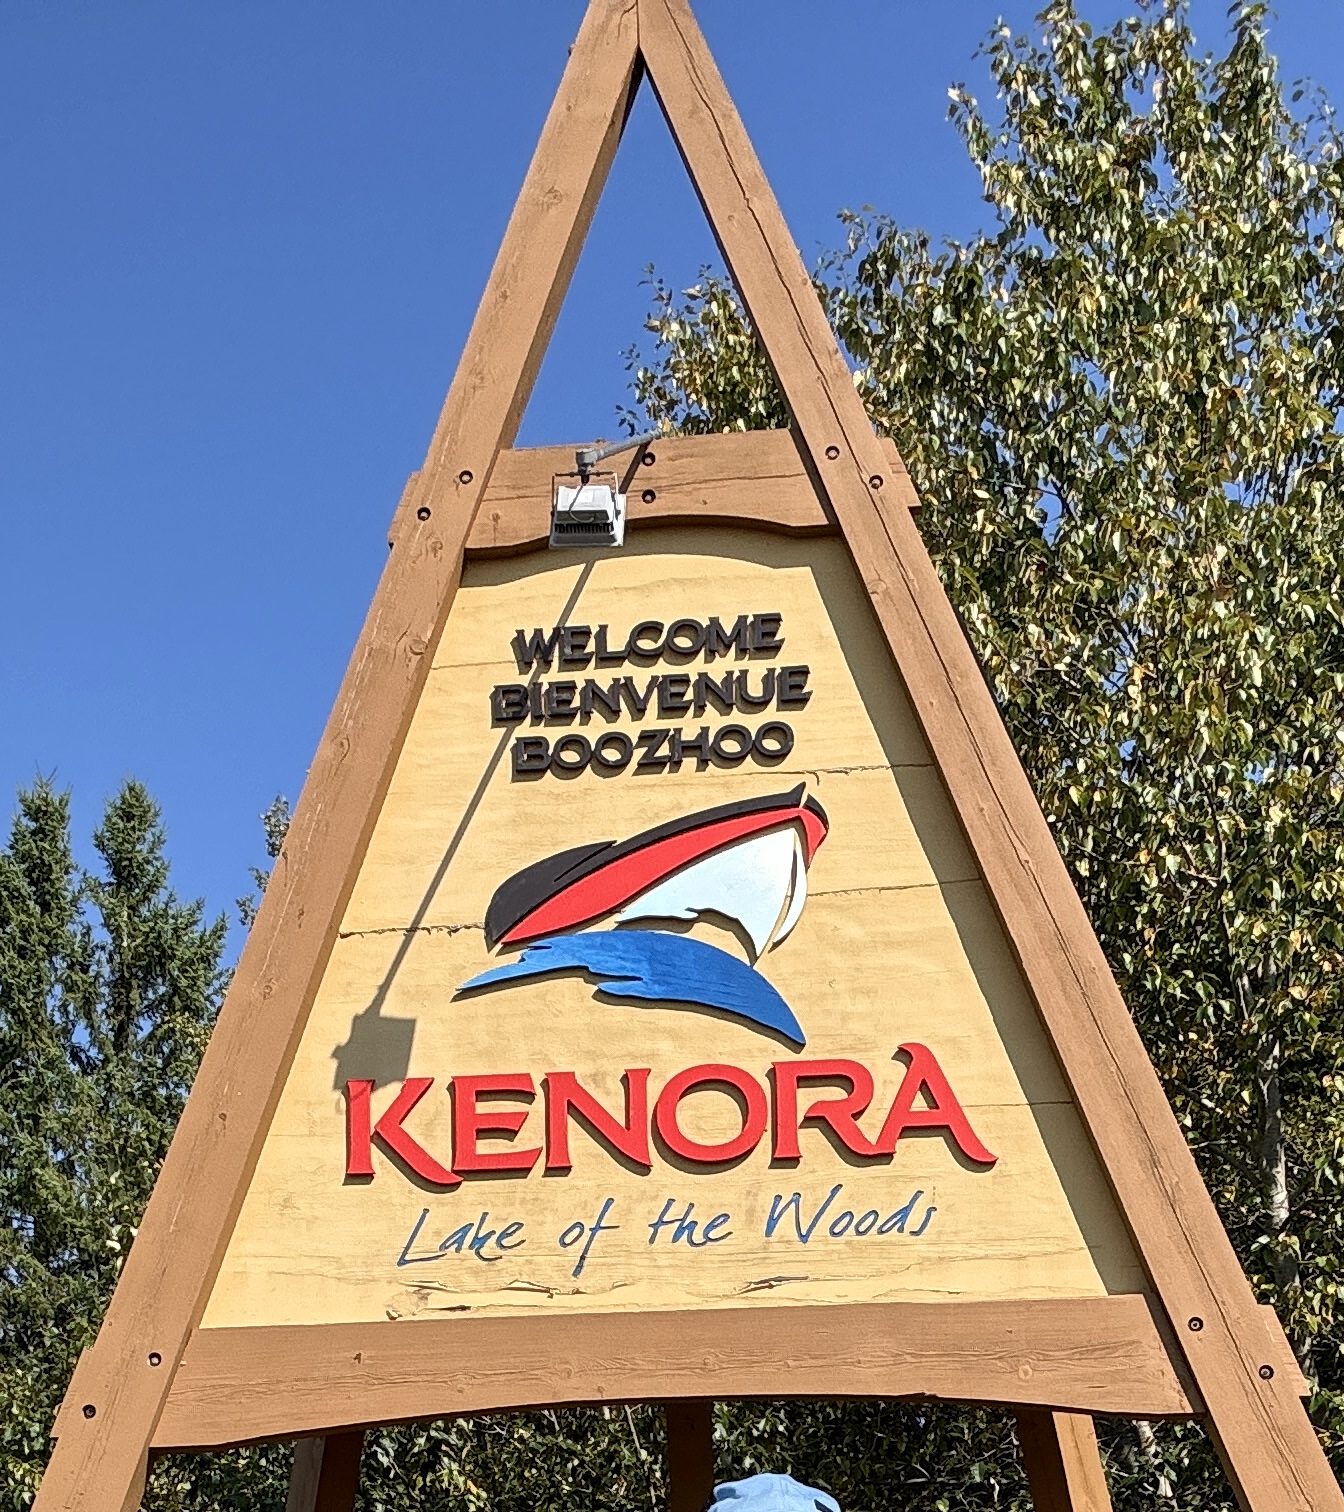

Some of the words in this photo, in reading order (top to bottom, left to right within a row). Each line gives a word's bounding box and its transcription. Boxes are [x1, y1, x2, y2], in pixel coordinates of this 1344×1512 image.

[511, 612, 785, 675] WELCOME
[491, 665, 813, 728] BIENVENUE
[511, 720, 795, 783] BOOZHOO
[343, 1042, 999, 1188] KENORA
[396, 1208, 527, 1268] Lake
[557, 1197, 619, 1278] of
[648, 1198, 734, 1246] the
[763, 1184, 936, 1244] Woods
